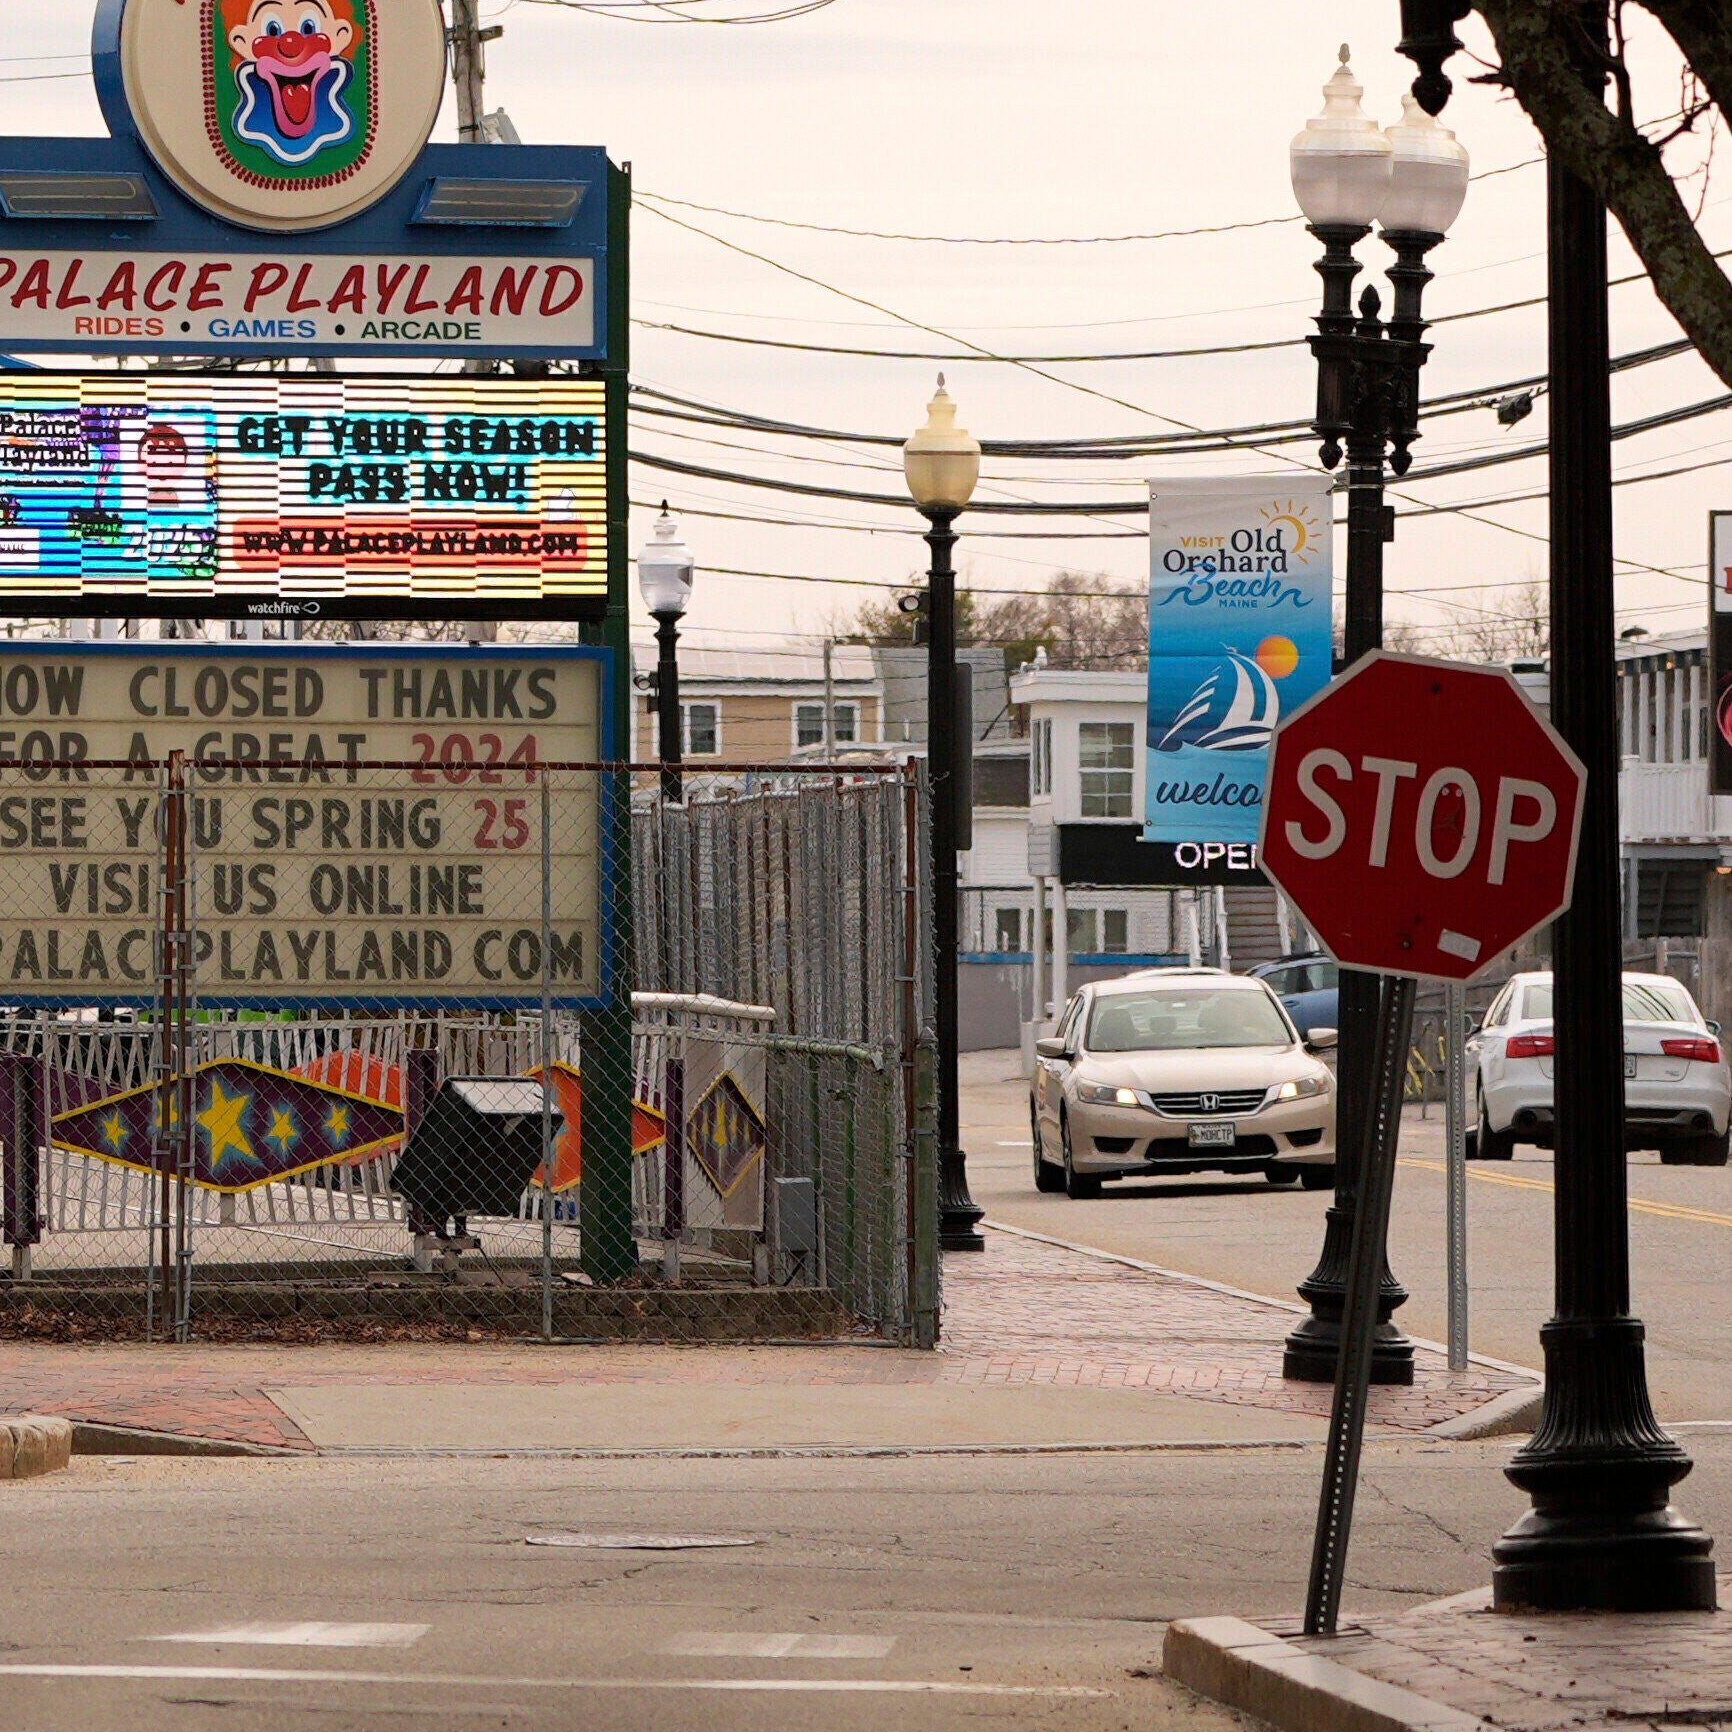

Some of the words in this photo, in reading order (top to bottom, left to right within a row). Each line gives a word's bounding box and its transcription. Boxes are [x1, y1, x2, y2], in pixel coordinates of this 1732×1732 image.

[243, 259, 585, 317] PLAYLAND
[74, 317, 165, 338] RIDES
[207, 318, 316, 340] GAMES
[360, 321, 482, 342] ARCADE
[237, 416, 311, 456] GET
[327, 416, 426, 456] YOUR
[444, 419, 593, 456] SEASON
[308, 463, 408, 501] PASS
[423, 462, 527, 504] NOW!
[1162, 549, 1289, 573] Orchard
[1180, 536, 1226, 548] VISIT
[1230, 528, 1284, 553] Old
[1173, 562, 1288, 606] Beach
[1218, 599, 1259, 609] MAINE
[247, 600, 301, 615] watchfire
[129, 666, 325, 719] CLOSED
[358, 668, 558, 720] THANKS
[123, 731, 156, 783] A
[193, 731, 367, 785] GREAT
[410, 733, 538, 785] 2024
[1156, 772, 1263, 807] welco
[252, 798, 442, 851] SPRING
[473, 799, 530, 851] 25
[1284, 747, 1557, 886] STOP
[213, 864, 277, 916] US
[309, 864, 484, 916] ONLINE
[473, 929, 583, 981] COM
